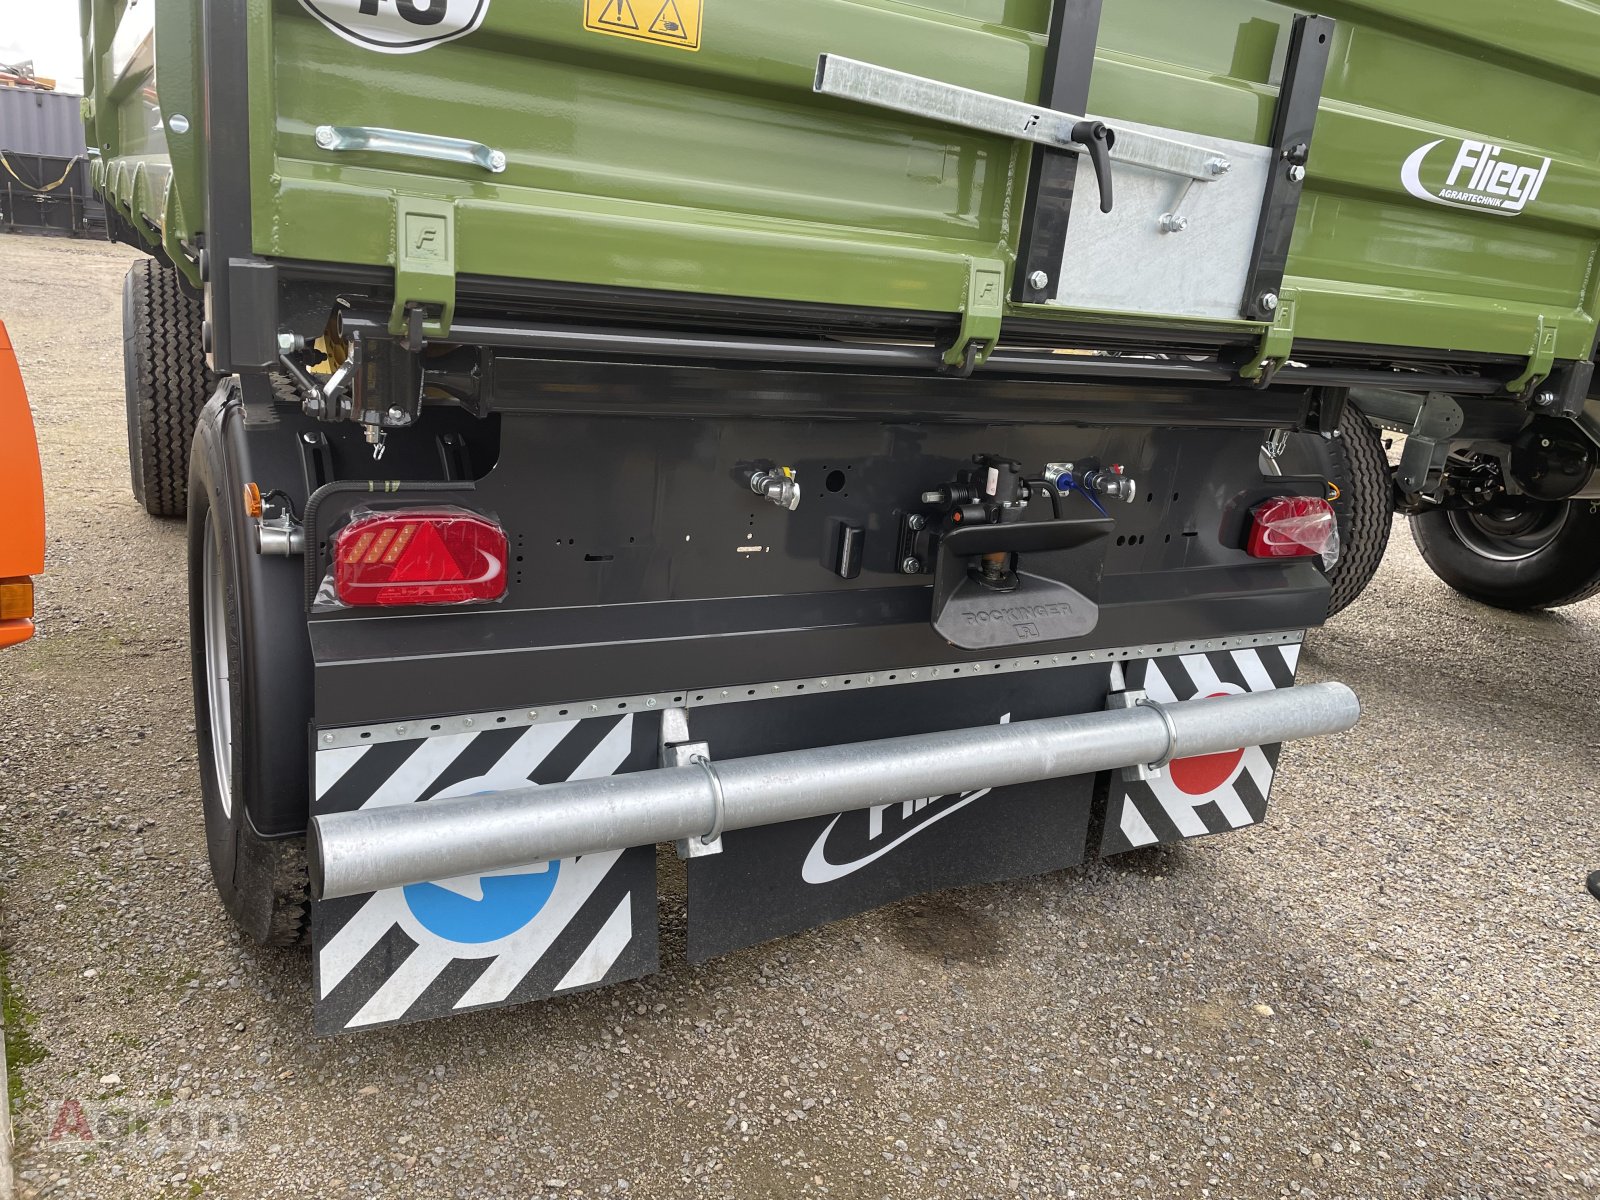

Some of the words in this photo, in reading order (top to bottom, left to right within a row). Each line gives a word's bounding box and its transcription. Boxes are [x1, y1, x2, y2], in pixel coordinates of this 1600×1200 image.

[1445, 139, 1552, 211] Fliegl
[1439, 188, 1503, 207] AGRARTECHNIK
[961, 602, 1073, 625] ROCKINGER
